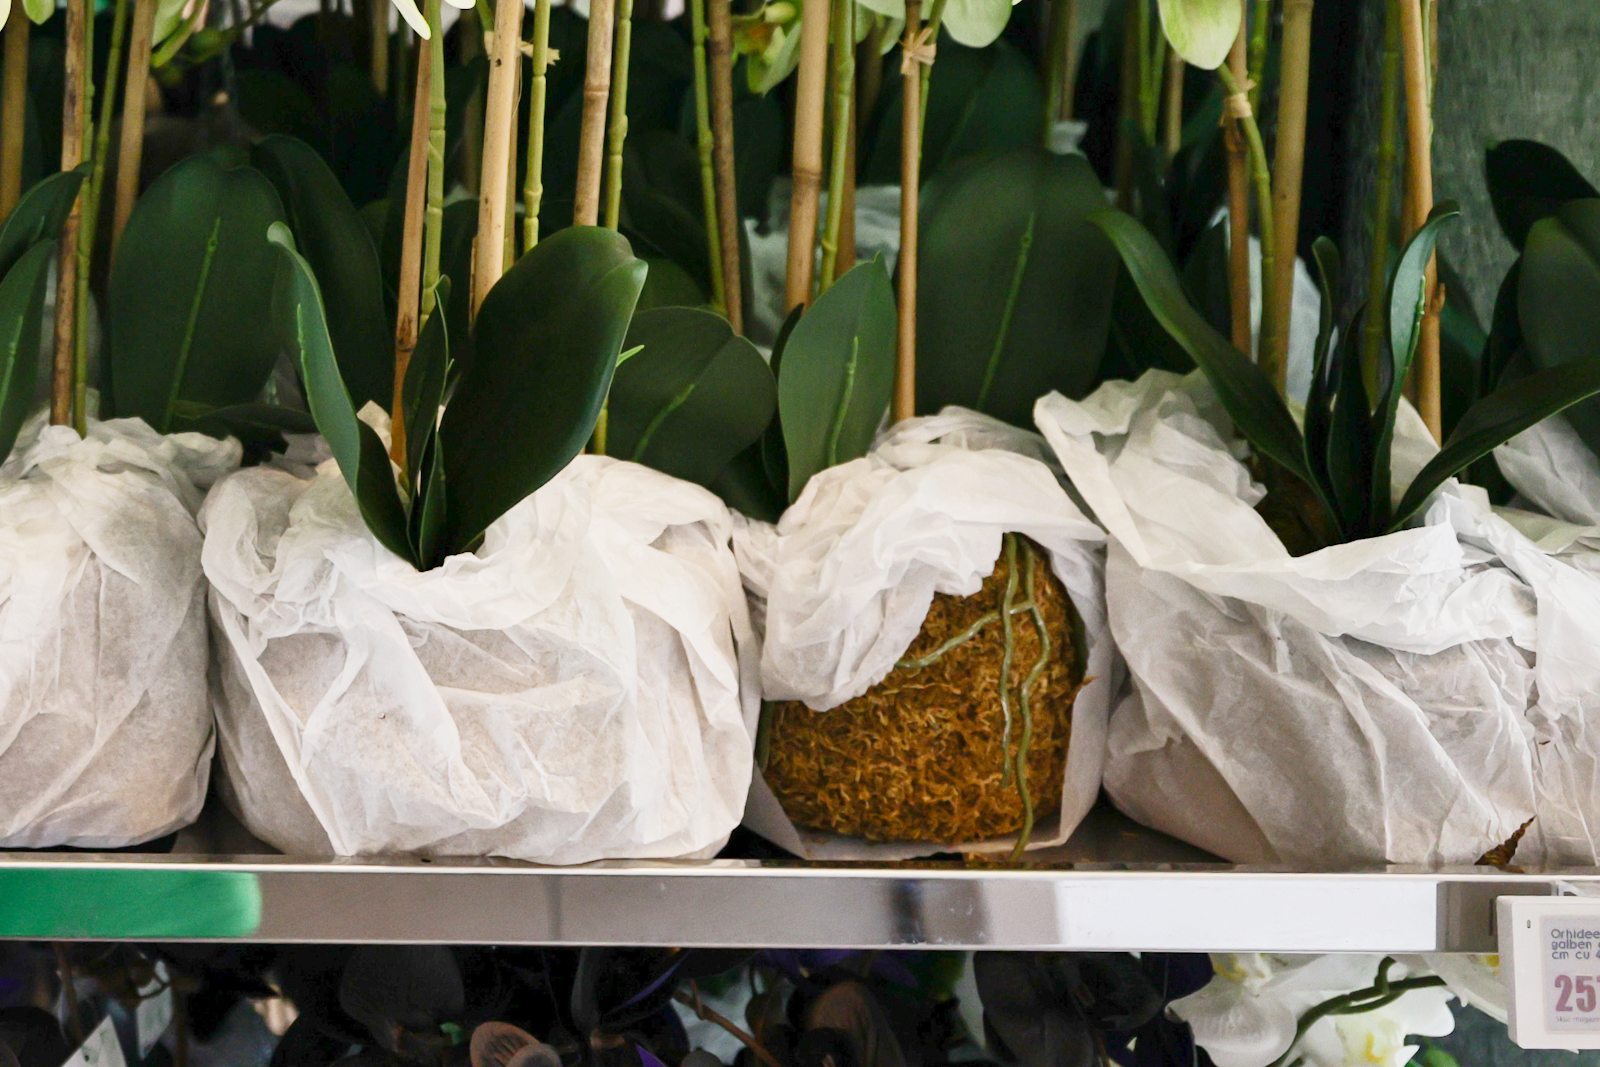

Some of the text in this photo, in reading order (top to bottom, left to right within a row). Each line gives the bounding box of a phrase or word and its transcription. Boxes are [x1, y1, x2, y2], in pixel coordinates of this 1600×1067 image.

[1550, 928, 1600, 939] Orhidee
[1551, 939, 1592, 950] galben
[1551, 951, 1590, 960] cm cu
[1554, 974, 1600, 1012] 25
